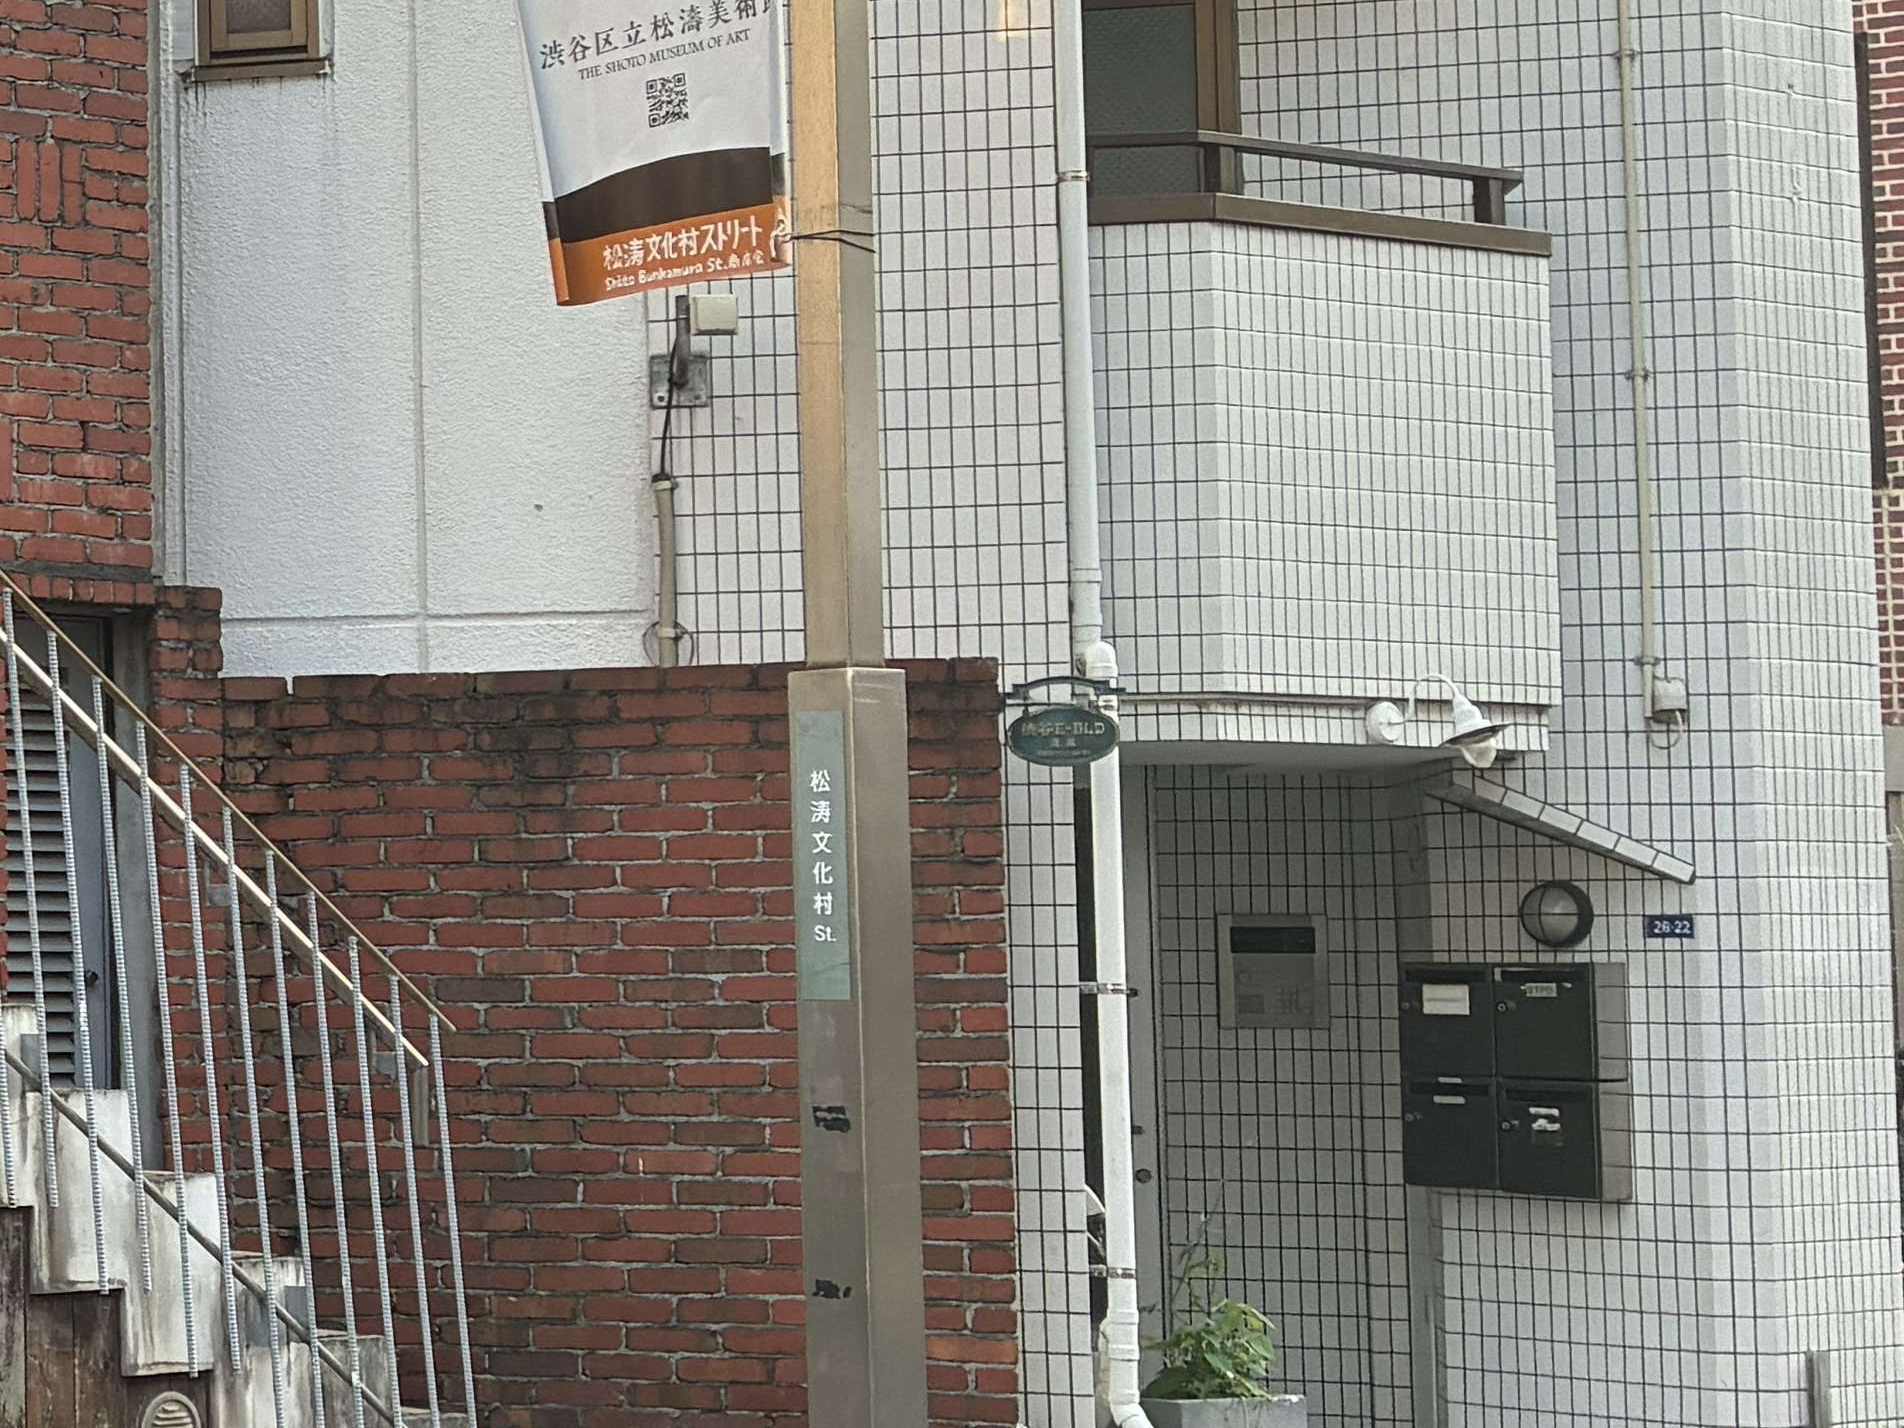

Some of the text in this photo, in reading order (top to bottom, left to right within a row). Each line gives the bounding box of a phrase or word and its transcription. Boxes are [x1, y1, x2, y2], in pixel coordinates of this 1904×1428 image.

[577, 28, 752, 81] THE SHOTO MUSEUM OF ART
